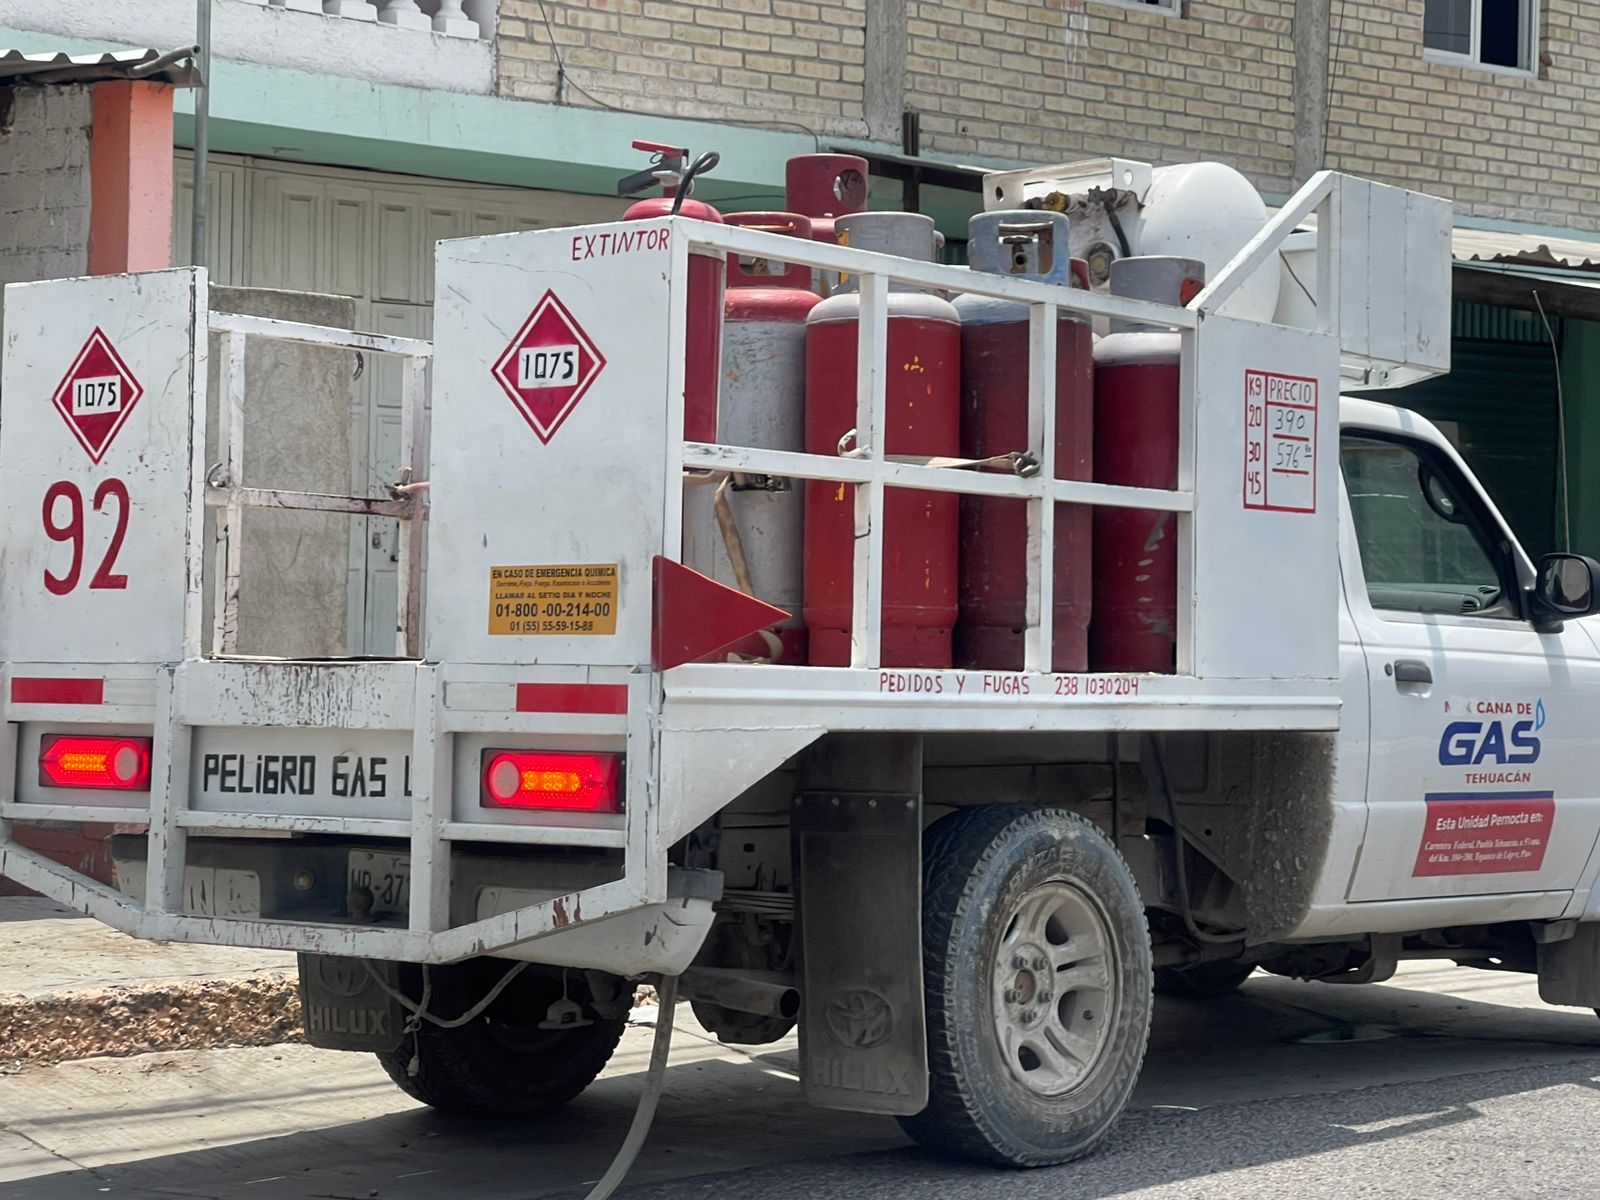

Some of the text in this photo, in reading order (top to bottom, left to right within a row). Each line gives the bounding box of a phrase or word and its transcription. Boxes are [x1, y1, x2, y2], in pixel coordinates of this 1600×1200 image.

[572, 228, 670, 261] EXTINTOR
[525, 351, 574, 379] 1075
[77, 382, 116, 408] 1075
[1270, 379, 1312, 404] PRECIO
[1248, 404, 1306, 432] 20 390
[1248, 441, 1261, 462] 30
[1276, 442, 1300, 468] 576
[1247, 470, 1262, 495] 45
[42, 478, 130, 596] 92
[492, 569, 503, 579] EN
[504, 569, 523, 578] CASO
[525, 569, 534, 578] DE
[536, 568, 582, 577] EMERGENCIA
[495, 603, 538, 617] 01-800
[510, 621, 520, 631] 01
[523, 620, 540, 632] (55)
[879, 672, 1139, 696] PEDIDOS Y FUGAS 238 1030204
[1517, 703, 1532, 715] DE
[1438, 720, 1541, 766] GAS
[331, 755, 387, 797] GAS
[1465, 770, 1531, 784] TEHUACÁN
[1436, 818, 1456, 831] Esta
[1458, 815, 1489, 829] Unidad
[1490, 812, 1529, 826] Pernocta
[308, 1003, 388, 1036] HILUX
